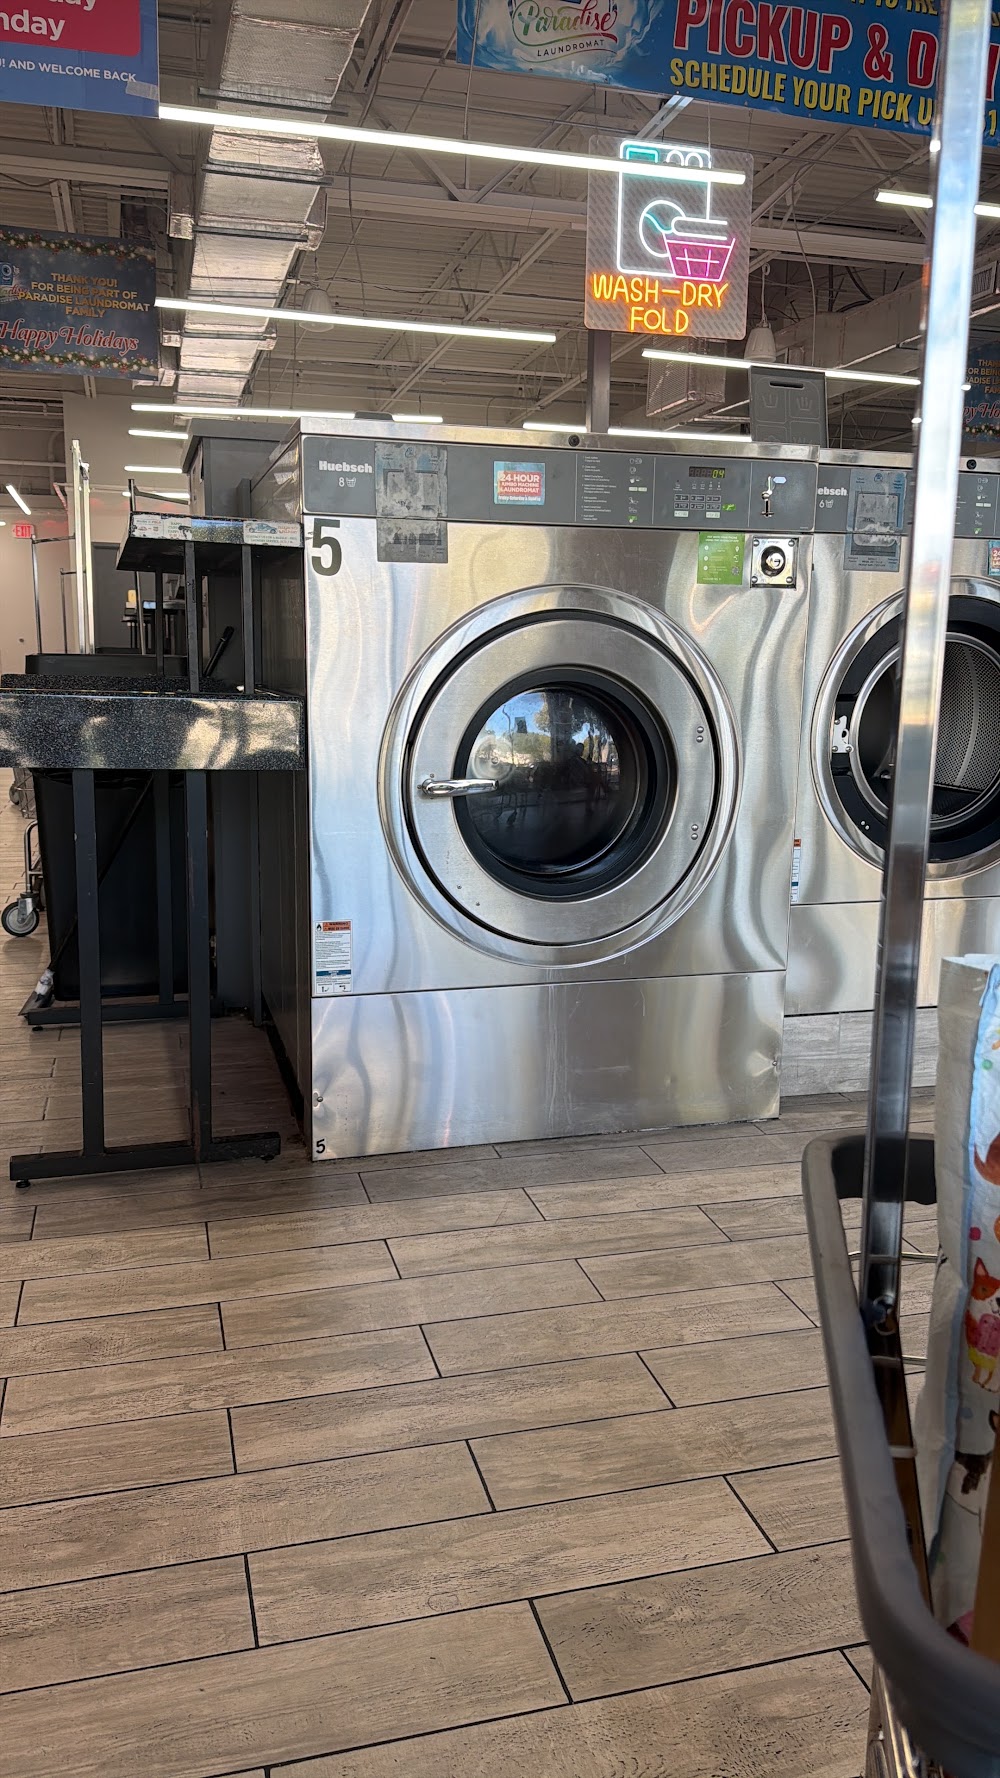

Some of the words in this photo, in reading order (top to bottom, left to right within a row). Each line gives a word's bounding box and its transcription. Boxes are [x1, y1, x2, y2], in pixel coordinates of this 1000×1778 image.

[537, 39, 606, 57] LAUNDROMAT
[673, 0, 852, 74] PICKUP
[863, 22, 894, 83] &
[9, 59, 36, 71] AND
[38, 62, 101, 79] WELCOME
[103, 71, 137, 83] BACK
[670, 58, 787, 103] SCHEDULE
[792, 75, 851, 114] YOUR
[857, 87, 913, 123] PICK
[917, 97, 936, 126] U
[51, 272, 89, 285] THANK
[91, 278, 118, 288] YOU!
[31, 281, 54, 292] FOR
[56, 284, 90, 296] BEING
[91, 288, 120, 299] PART
[122, 290, 138, 300] OF
[18, 291, 73, 304] PARADISE
[75, 297, 150, 312] LAUNDROMAT
[65, 306, 106, 318] FAMILY
[630, 306, 690, 334] FOLD
[0, 318, 58, 350] Happy
[60, 323, 139, 357] Holidays
[318, 460, 373, 474] Huebsch
[338, 476, 345, 488] 8
[818, 499, 825, 509] 6
[16, 525, 31, 537] EXIT
[311, 517, 343, 577] 5
[315, 1138, 326, 1154] 5
